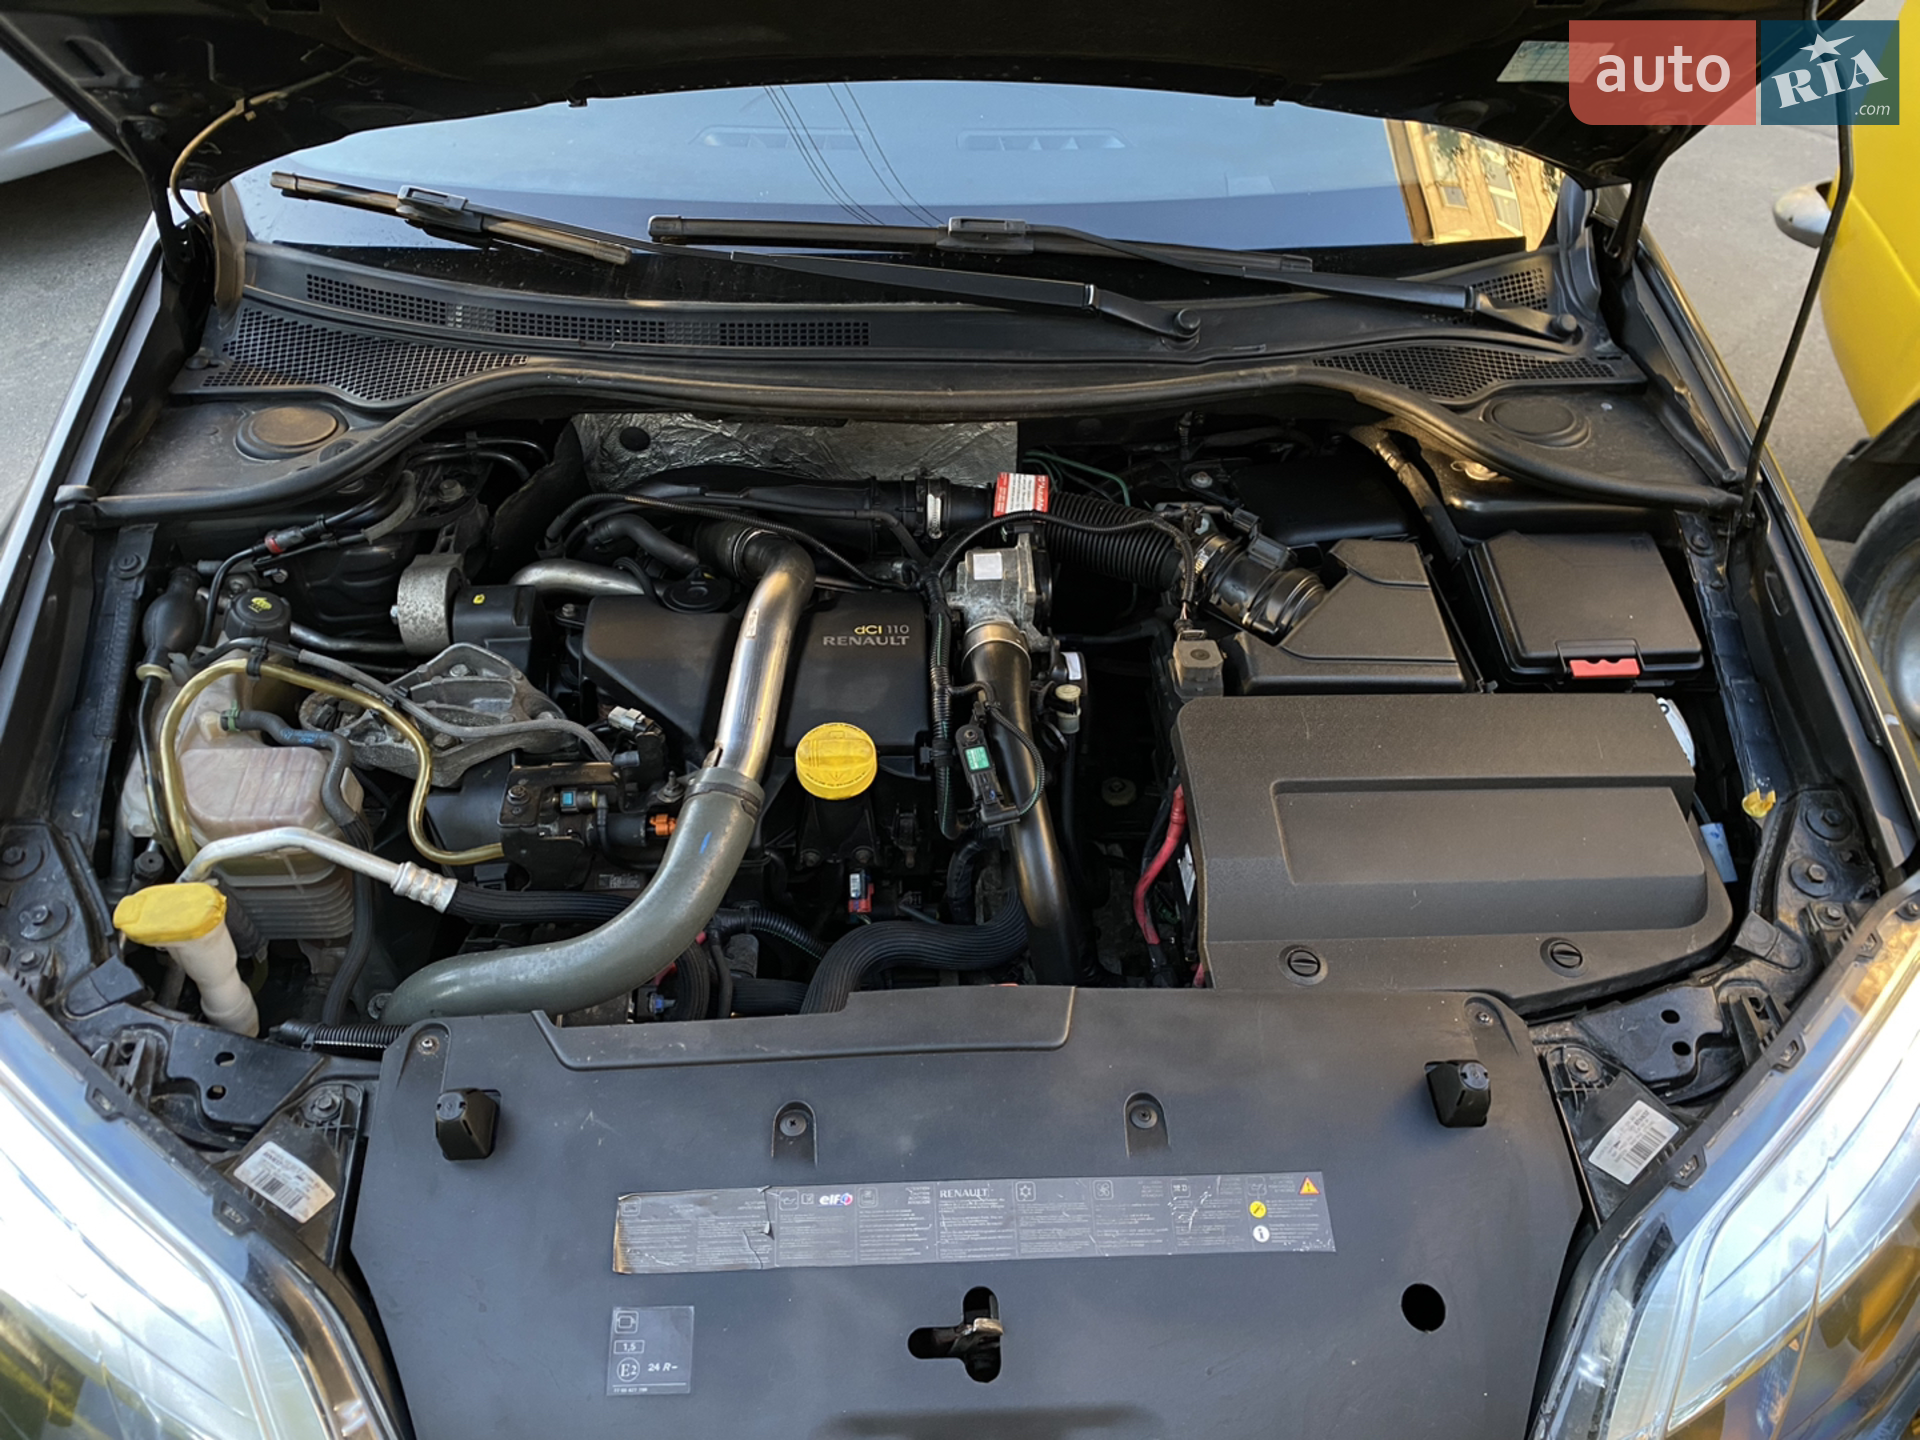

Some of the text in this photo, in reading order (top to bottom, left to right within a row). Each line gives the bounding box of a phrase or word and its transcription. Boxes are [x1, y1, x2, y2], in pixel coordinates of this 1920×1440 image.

[887, 624, 910, 635] 110
[823, 635, 910, 646] RENAULT
[939, 1188, 988, 1198] RENAULT
[819, 1193, 841, 1205] elf
[623, 1343, 636, 1353] 1,5
[620, 1363, 638, 1377] E2
[647, 1362, 660, 1372] 24
